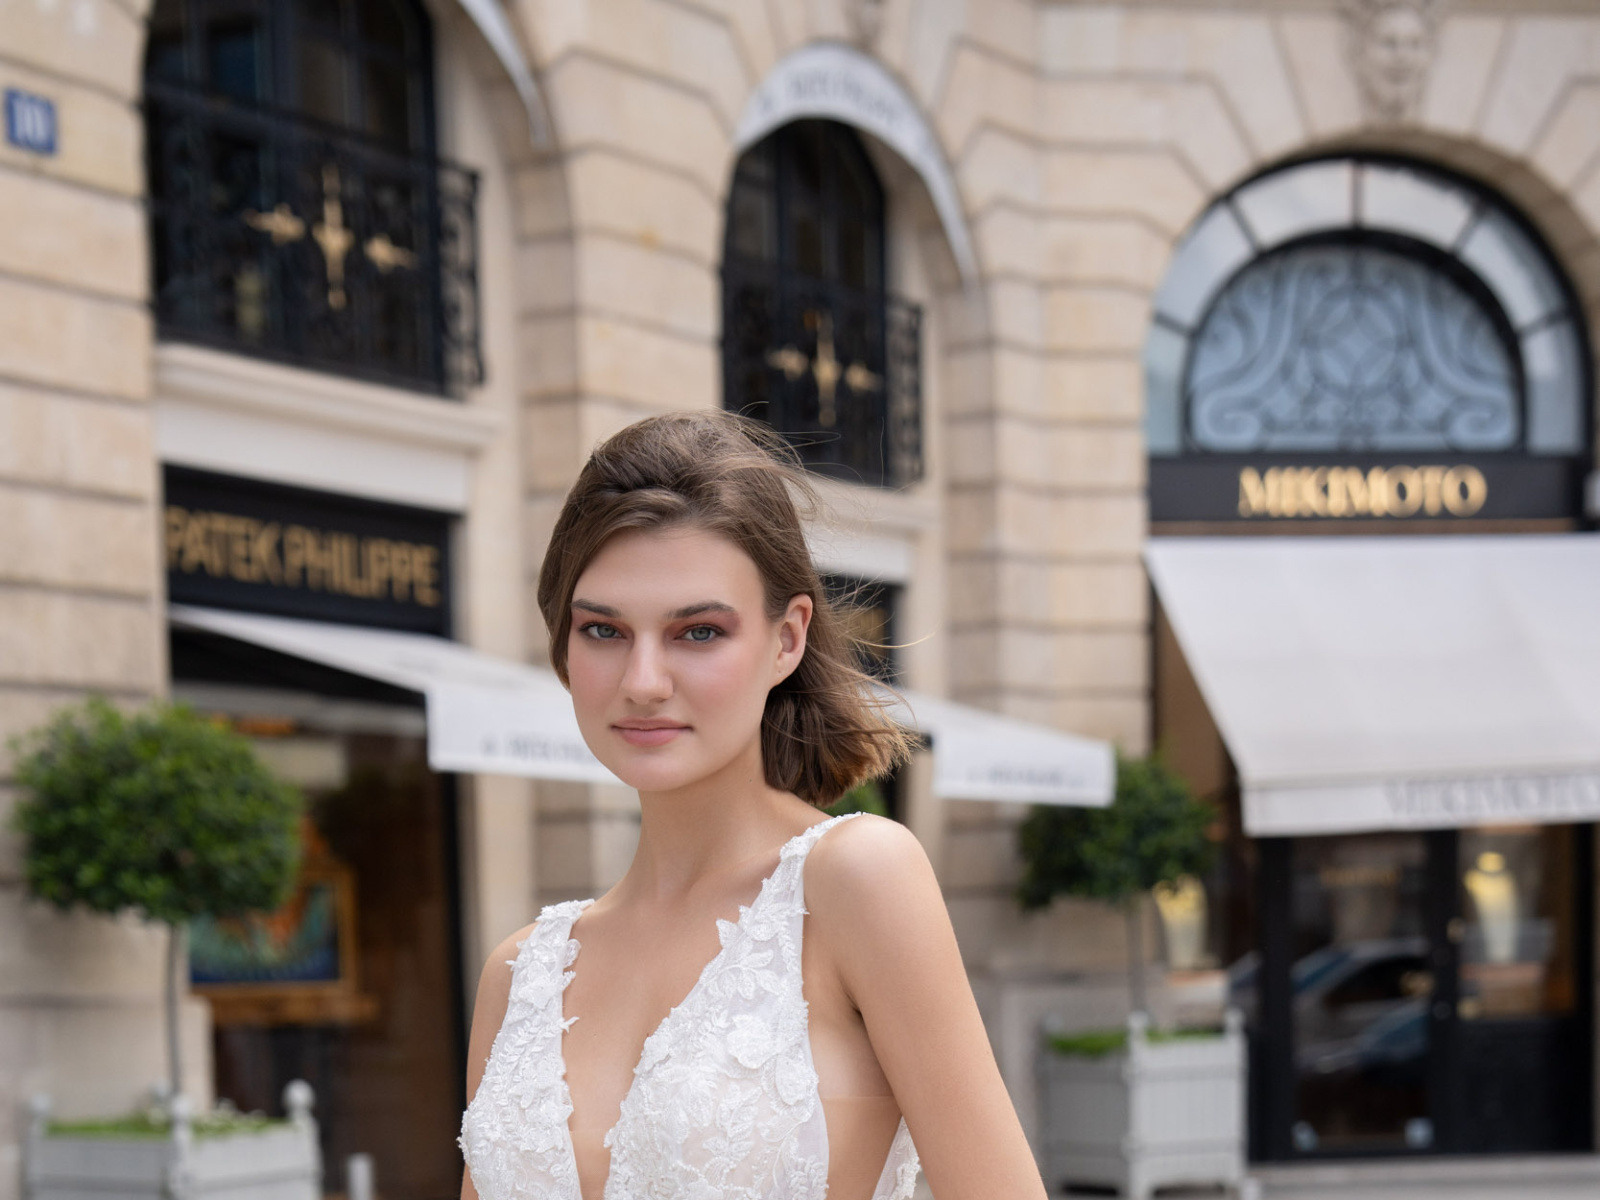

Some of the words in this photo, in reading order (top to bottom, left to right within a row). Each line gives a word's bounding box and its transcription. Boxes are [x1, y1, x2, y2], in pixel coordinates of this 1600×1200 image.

[1238, 465, 1487, 517] MIKIMOTO
[165, 505, 283, 586] PATEK
[283, 524, 438, 607] PHILIPPE
